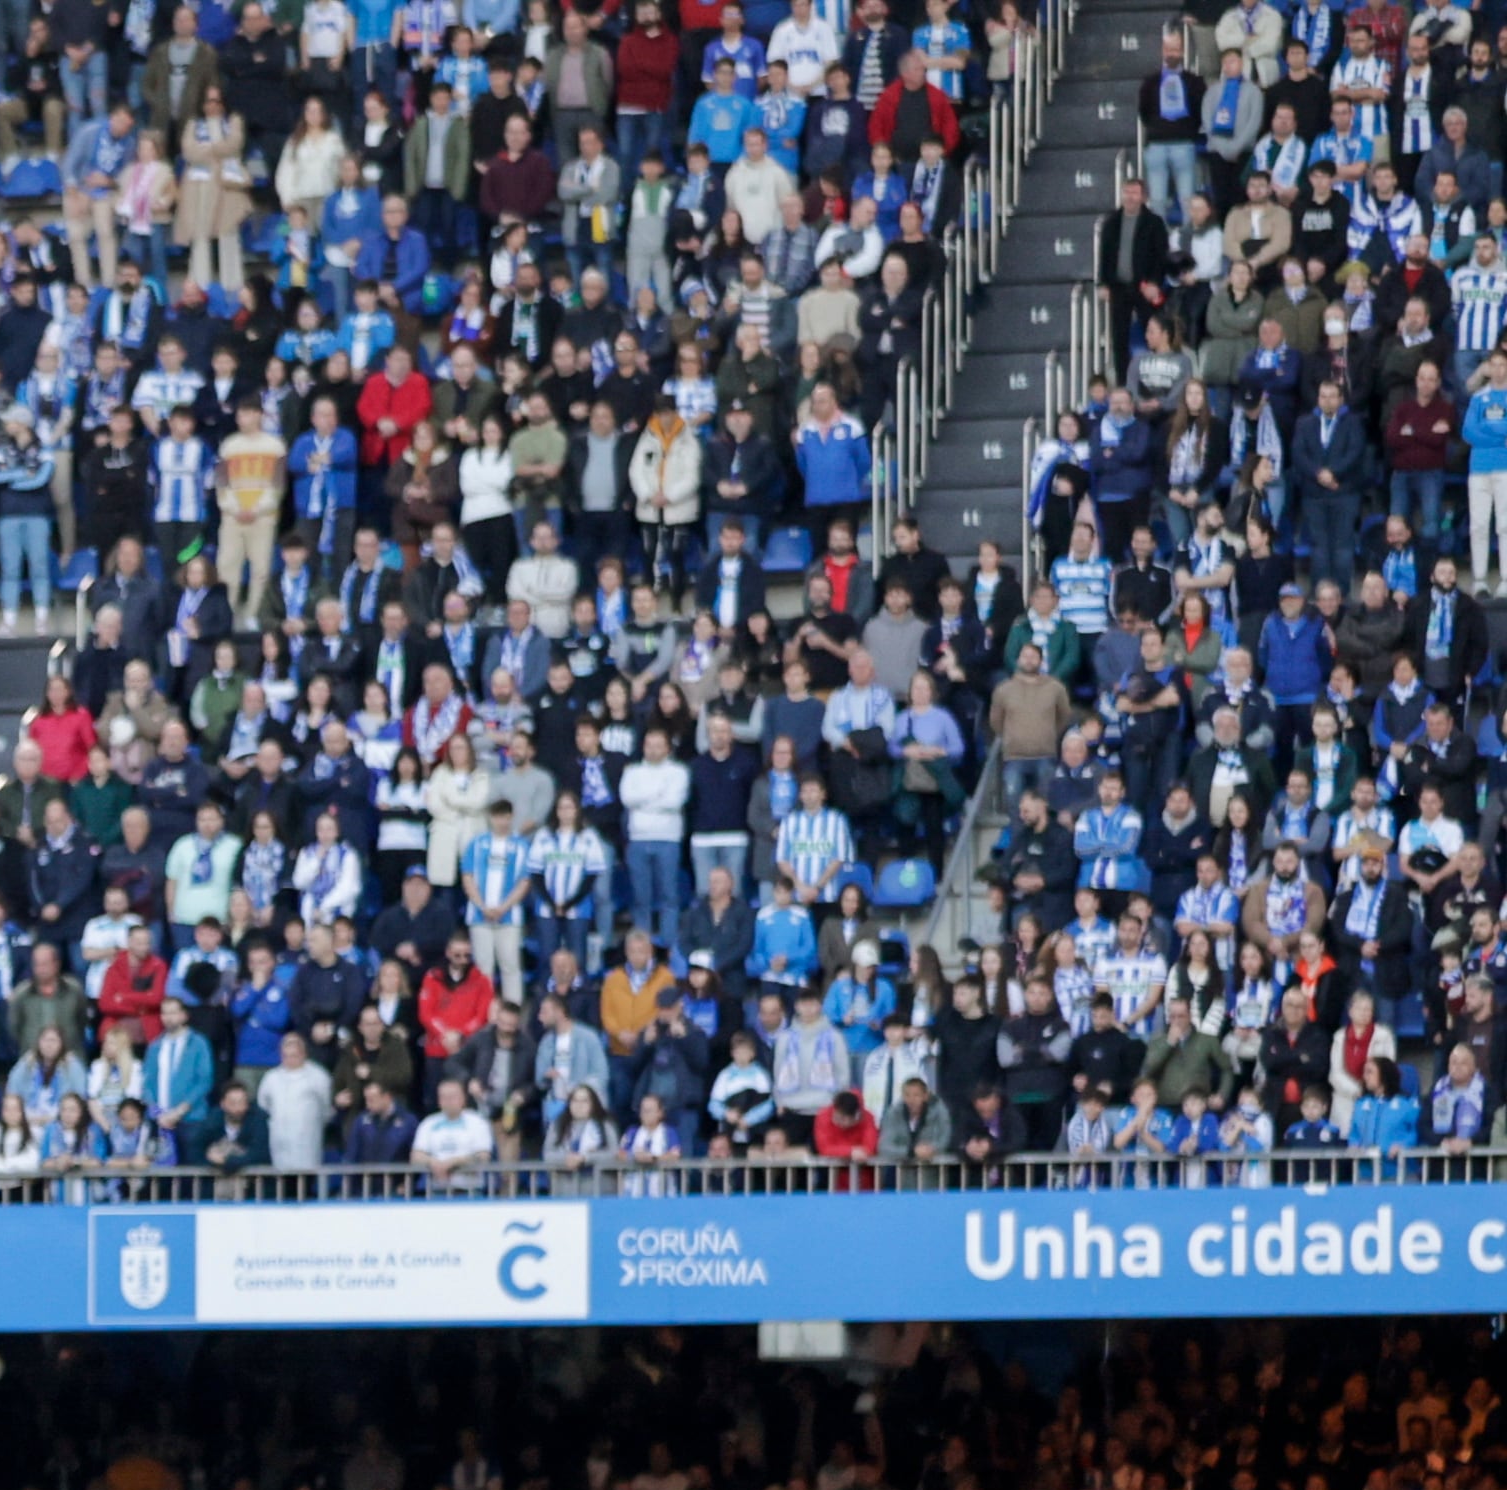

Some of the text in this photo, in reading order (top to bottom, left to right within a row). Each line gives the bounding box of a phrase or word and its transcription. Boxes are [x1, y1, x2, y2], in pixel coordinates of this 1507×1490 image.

[618, 1222, 740, 1256] CORUÑA
[964, 1208, 1164, 1281] Unha
[1187, 1205, 1443, 1278] cidade
